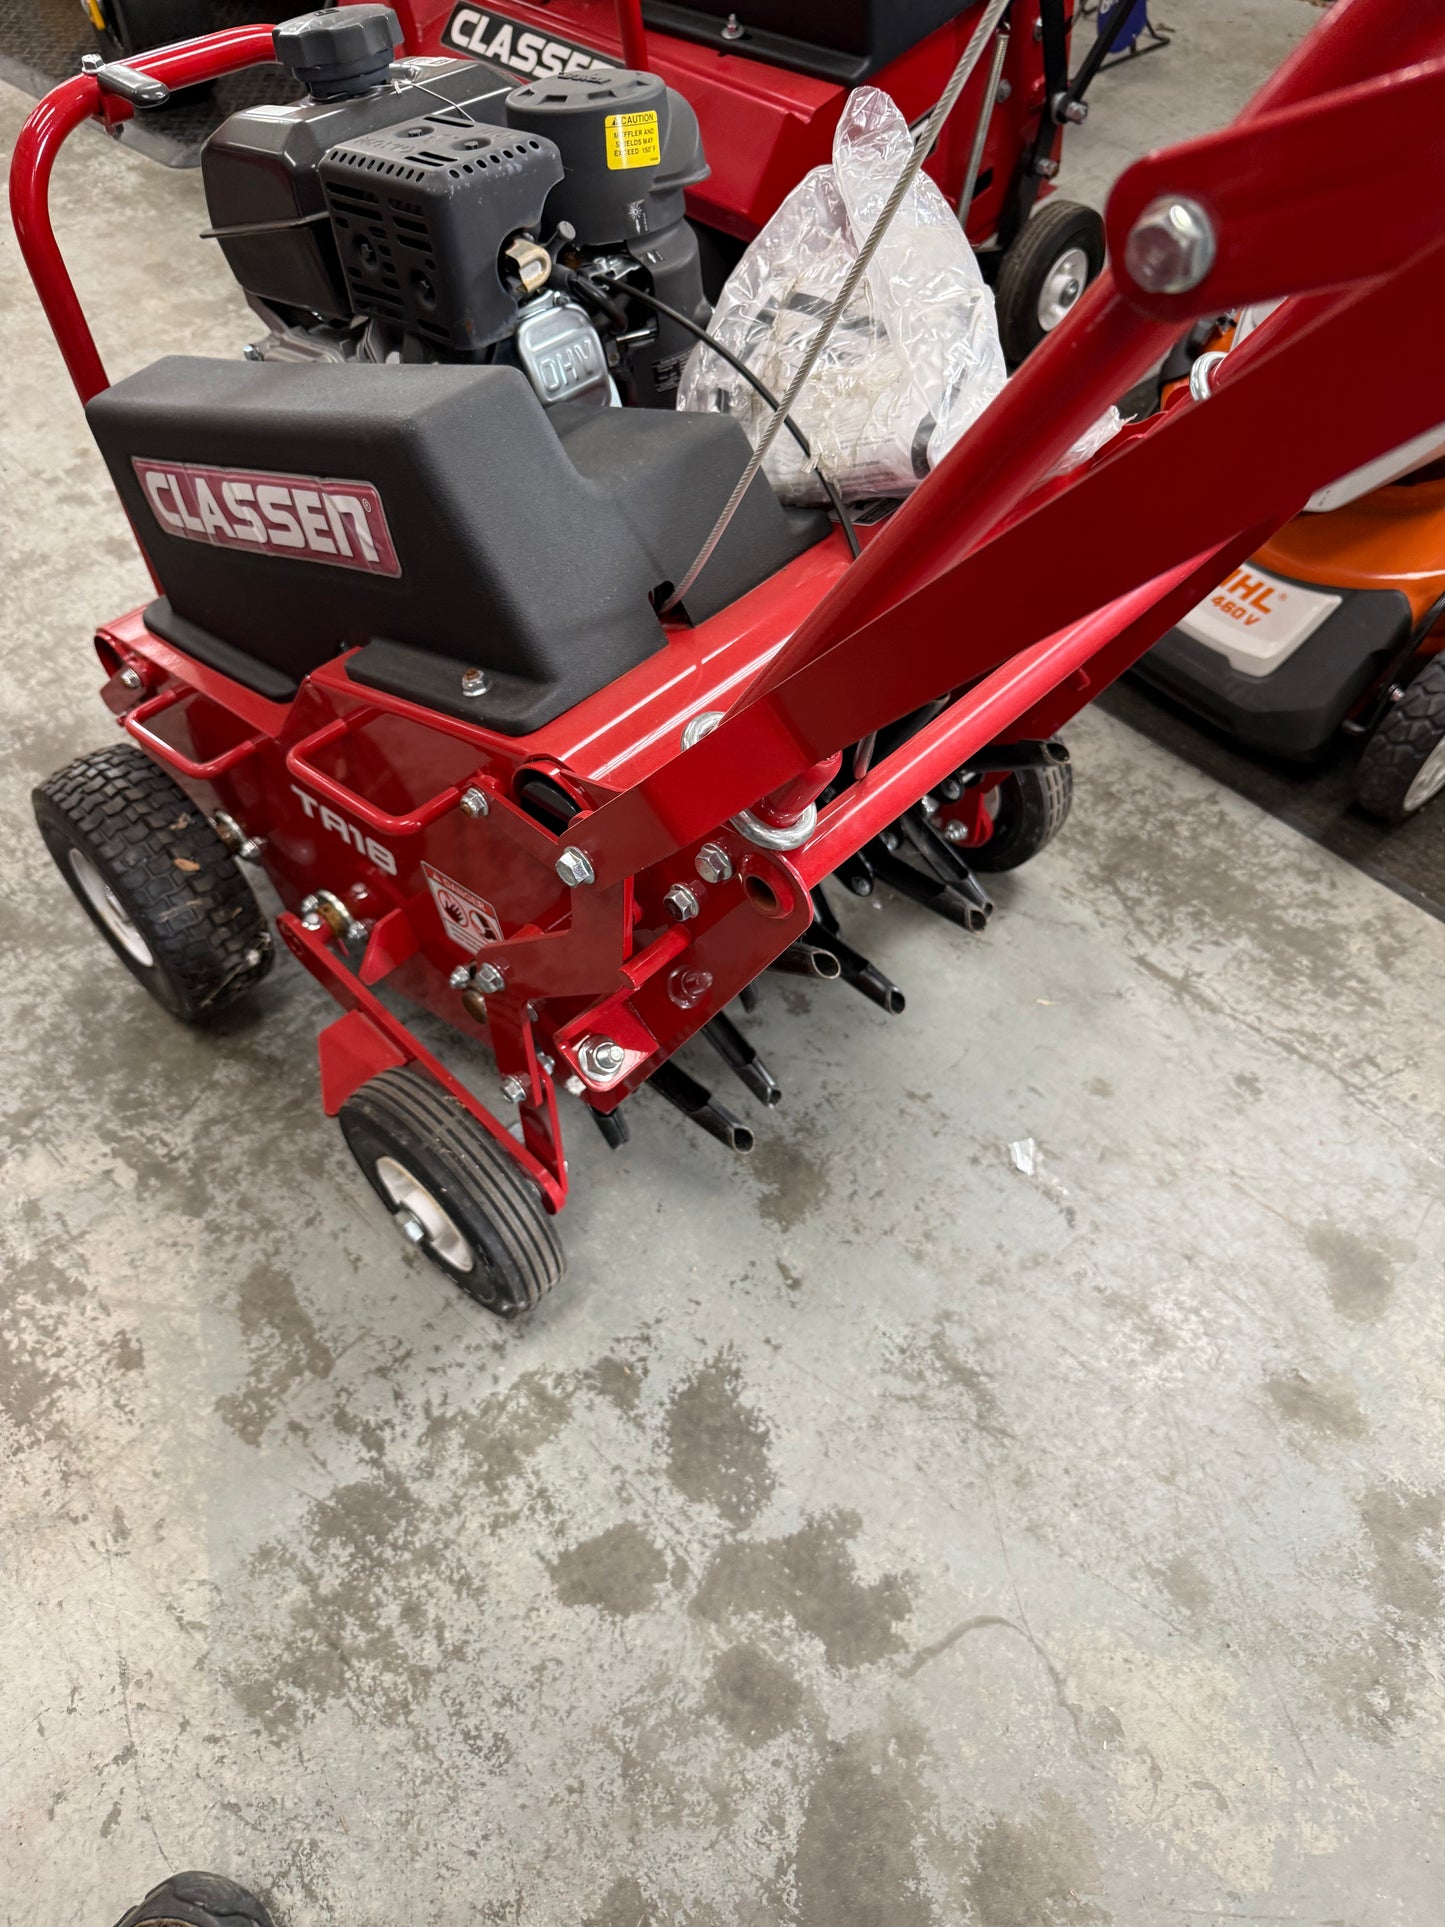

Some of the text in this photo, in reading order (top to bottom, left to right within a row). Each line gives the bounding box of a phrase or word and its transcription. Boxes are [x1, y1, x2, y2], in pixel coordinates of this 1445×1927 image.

[450, 8, 617, 79] CLASSE
[614, 130, 642, 139] MFFLER
[621, 113, 654, 125] CAUTION
[145, 471, 380, 562] CLASSEN
[1220, 567, 1275, 614] IHL
